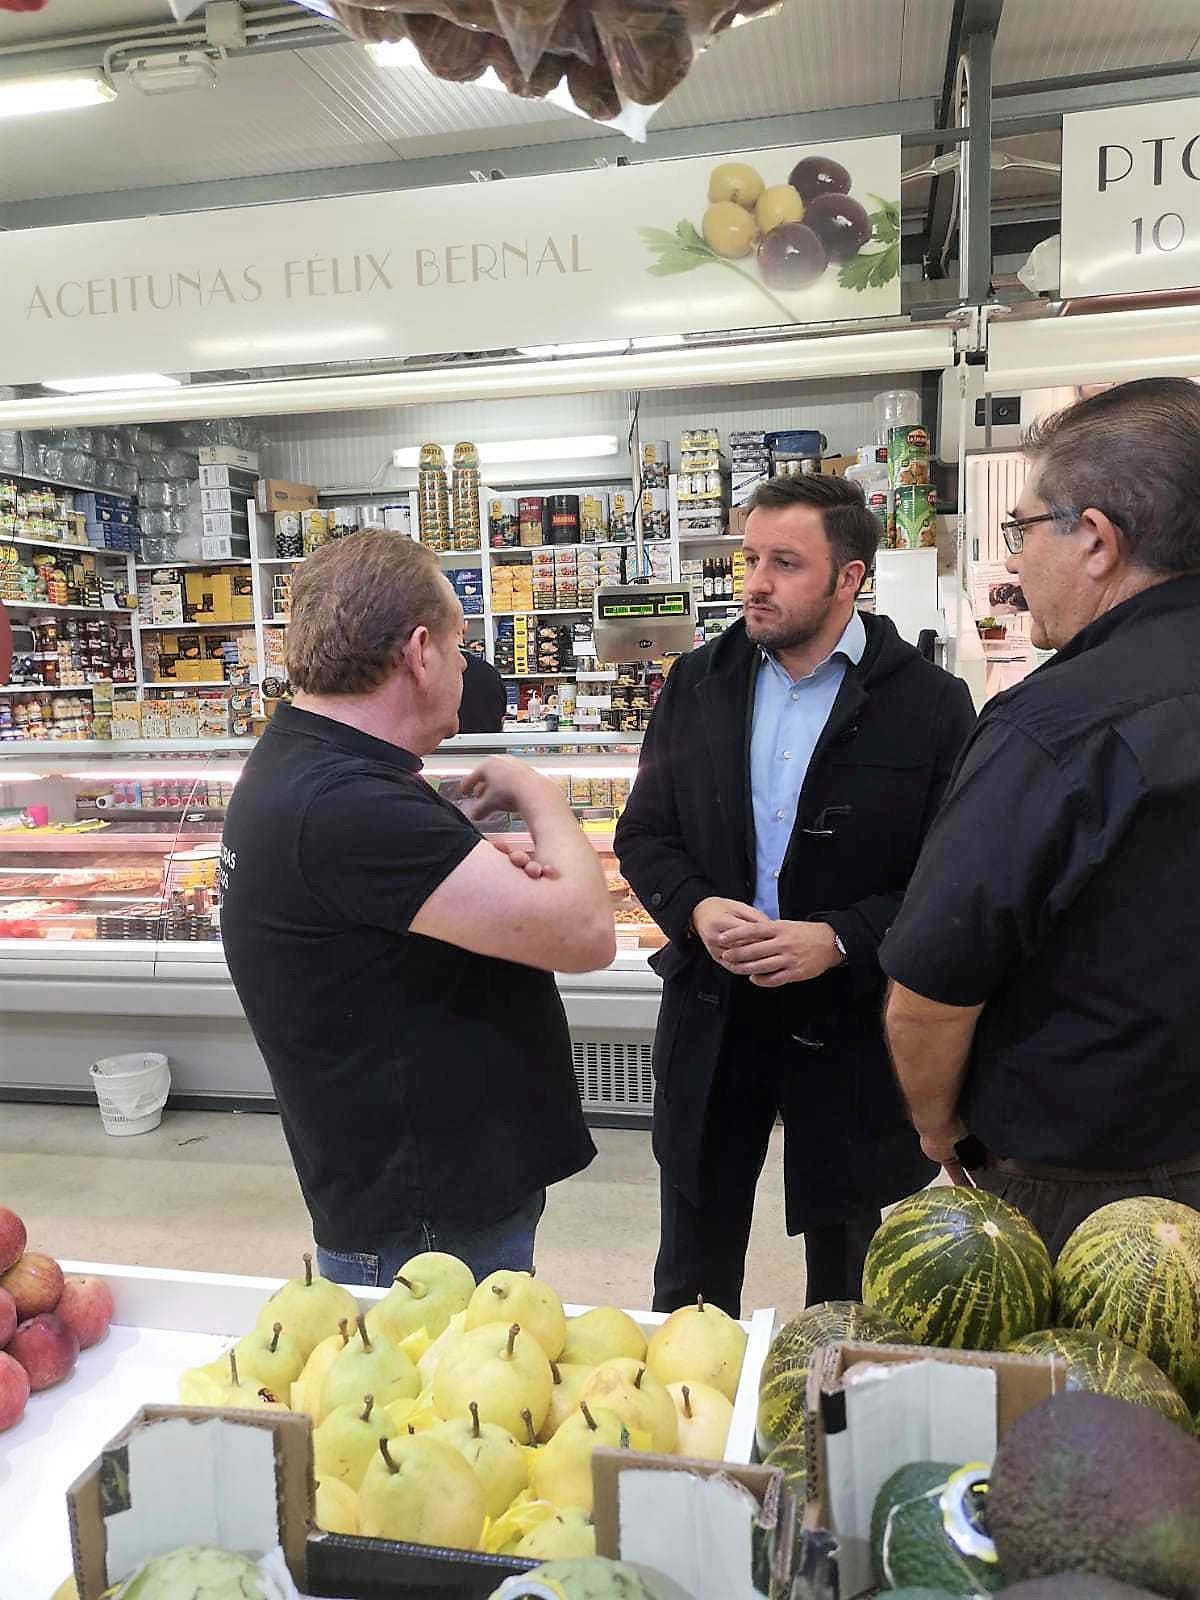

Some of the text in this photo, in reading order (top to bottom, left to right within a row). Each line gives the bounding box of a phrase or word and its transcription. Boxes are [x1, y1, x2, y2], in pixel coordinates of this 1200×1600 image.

[1131, 212, 1185, 255] 10
[26, 234, 593, 320] ACEITUNAS FÉLIX BERNAL
